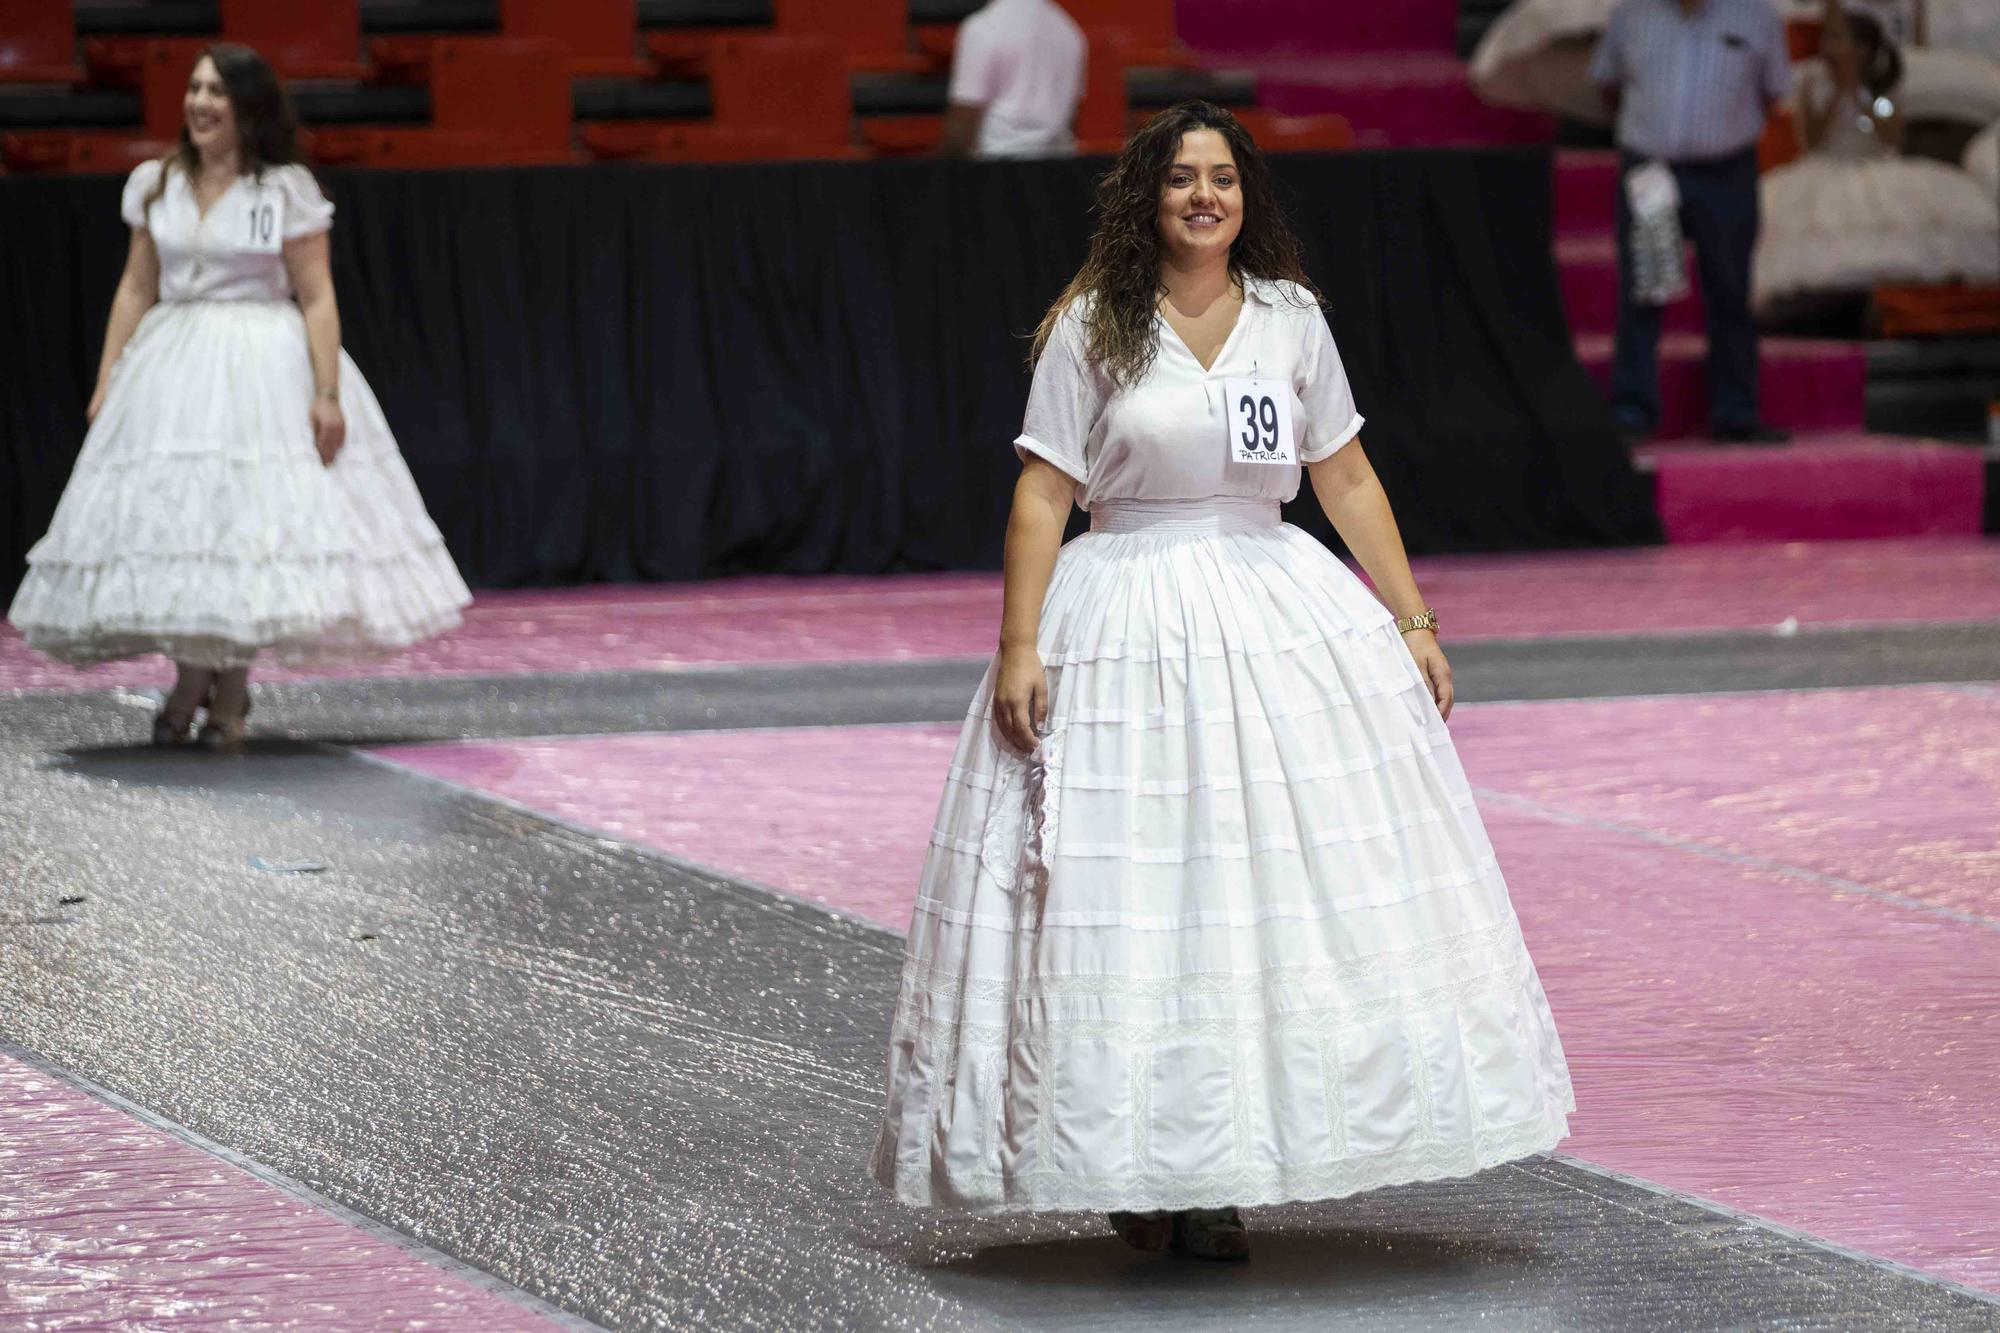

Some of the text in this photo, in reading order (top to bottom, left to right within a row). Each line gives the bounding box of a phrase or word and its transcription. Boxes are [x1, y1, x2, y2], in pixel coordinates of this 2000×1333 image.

[249, 204, 274, 245] 10
[1240, 395, 1279, 452] 39
[1239, 449, 1288, 461] PATRICIA
